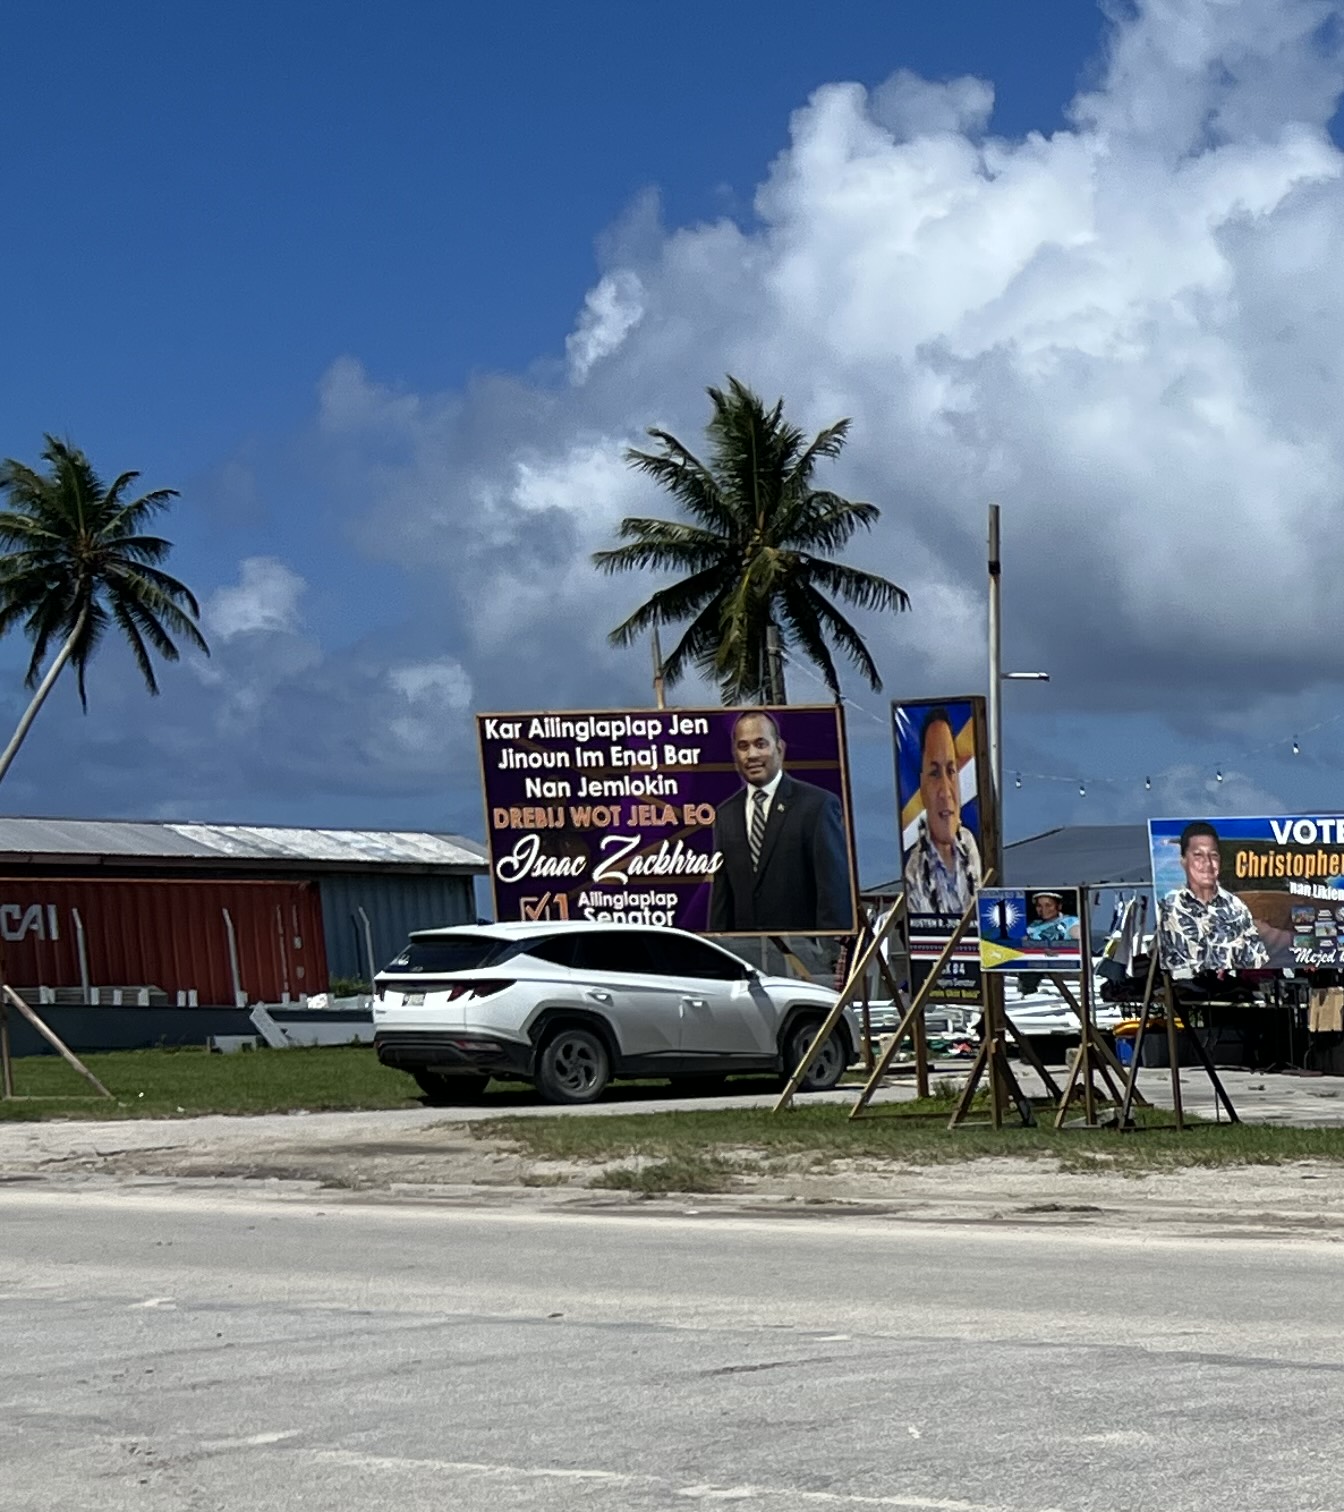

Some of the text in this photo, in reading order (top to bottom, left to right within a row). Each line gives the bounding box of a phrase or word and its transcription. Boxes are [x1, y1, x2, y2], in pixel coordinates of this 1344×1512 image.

[485, 715, 709, 741] Kar Ailinglaplap Jen
[498, 745, 701, 771] Jinoun Im Enaj Bar
[525, 775, 678, 799] Nan Jemlokin
[493, 803, 716, 830] DREBIJ WOT JELA EO
[496, 833, 723, 885] Isaac Zackhras
[578, 891, 678, 909] Ailinglaplap
[0, 904, 59, 941] CAI
[584, 907, 675, 927] Senator
